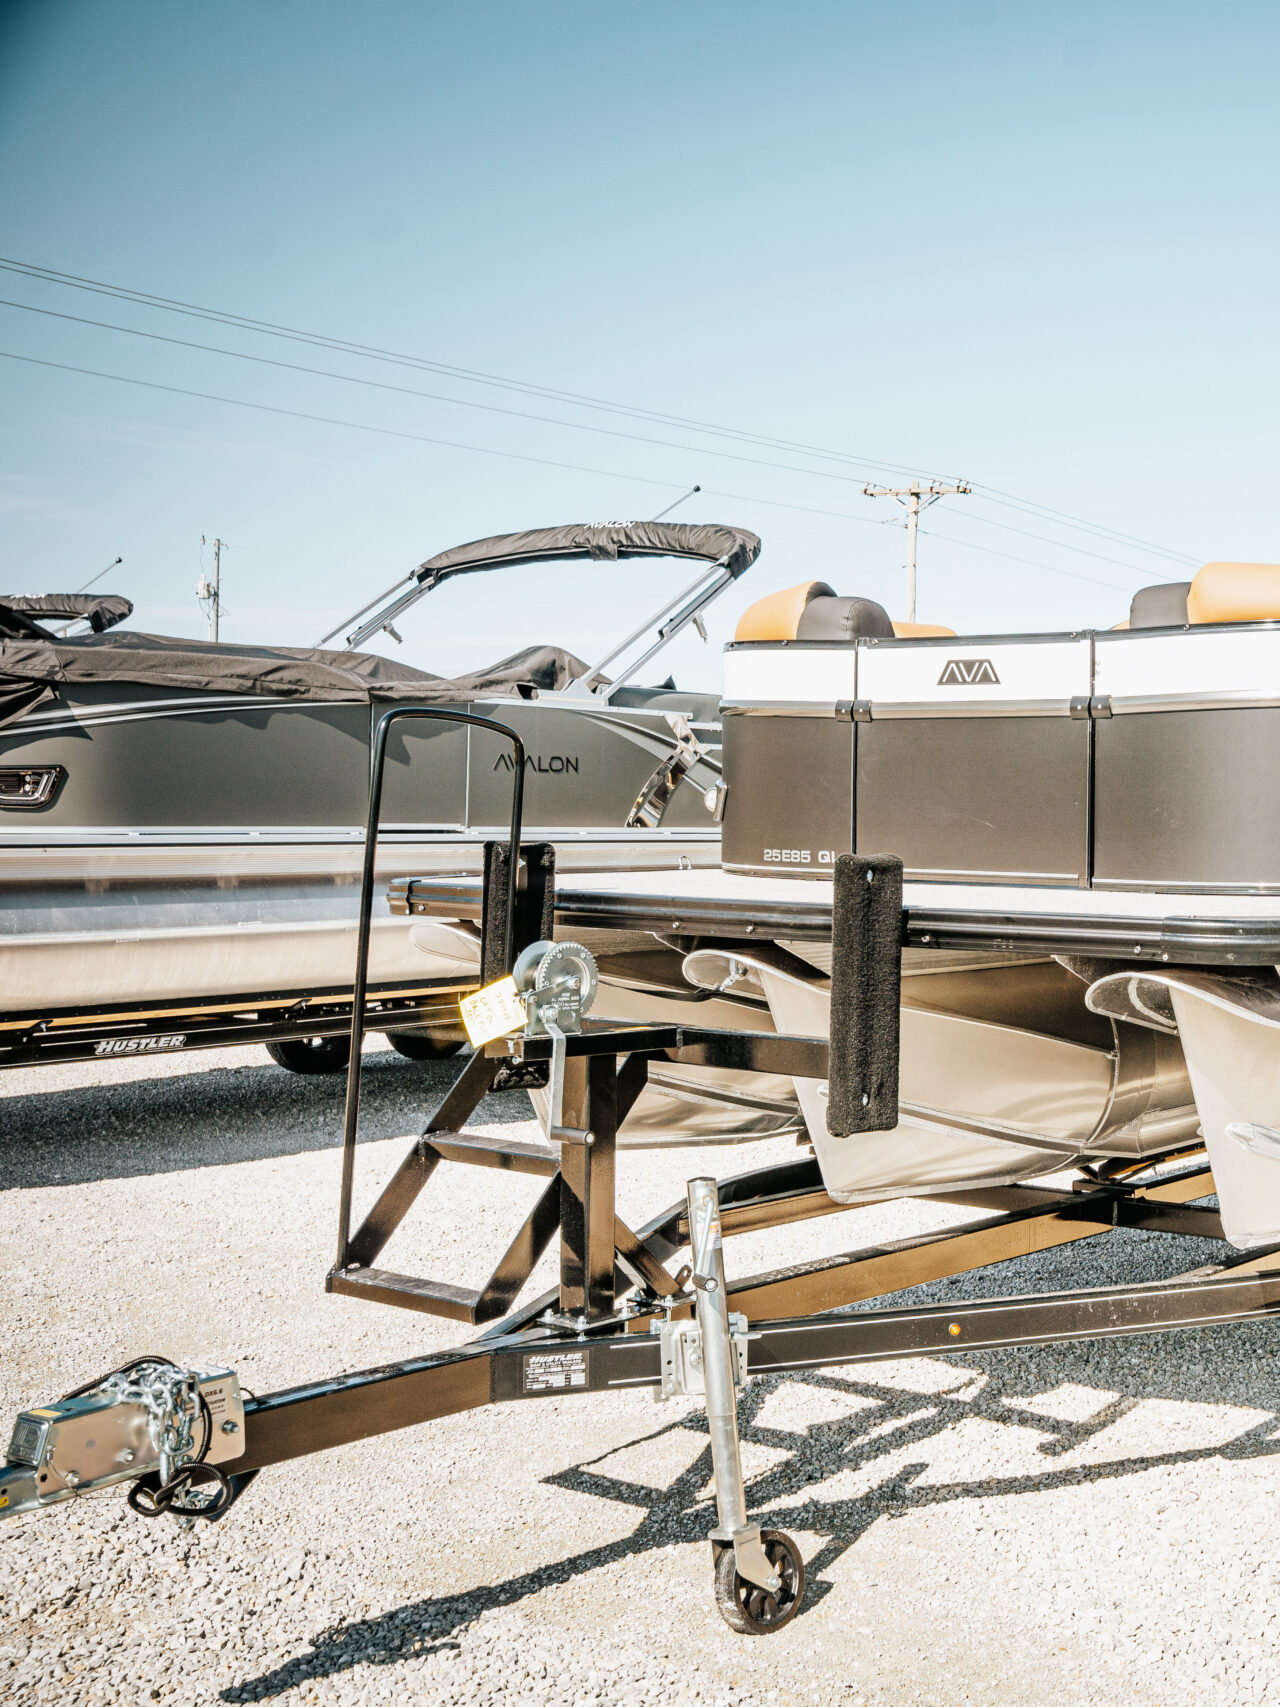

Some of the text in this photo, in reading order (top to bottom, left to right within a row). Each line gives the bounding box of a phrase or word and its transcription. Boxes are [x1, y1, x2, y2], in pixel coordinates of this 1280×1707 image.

[583, 521, 636, 529] AVALON
[942, 662, 998, 682] AVA
[763, 848, 811, 863] 25E85
[94, 1035, 186, 1056] HUSTLER
[529, 1353, 583, 1364] HUSTLER
[208, 1397, 226, 1405] TUATOR
